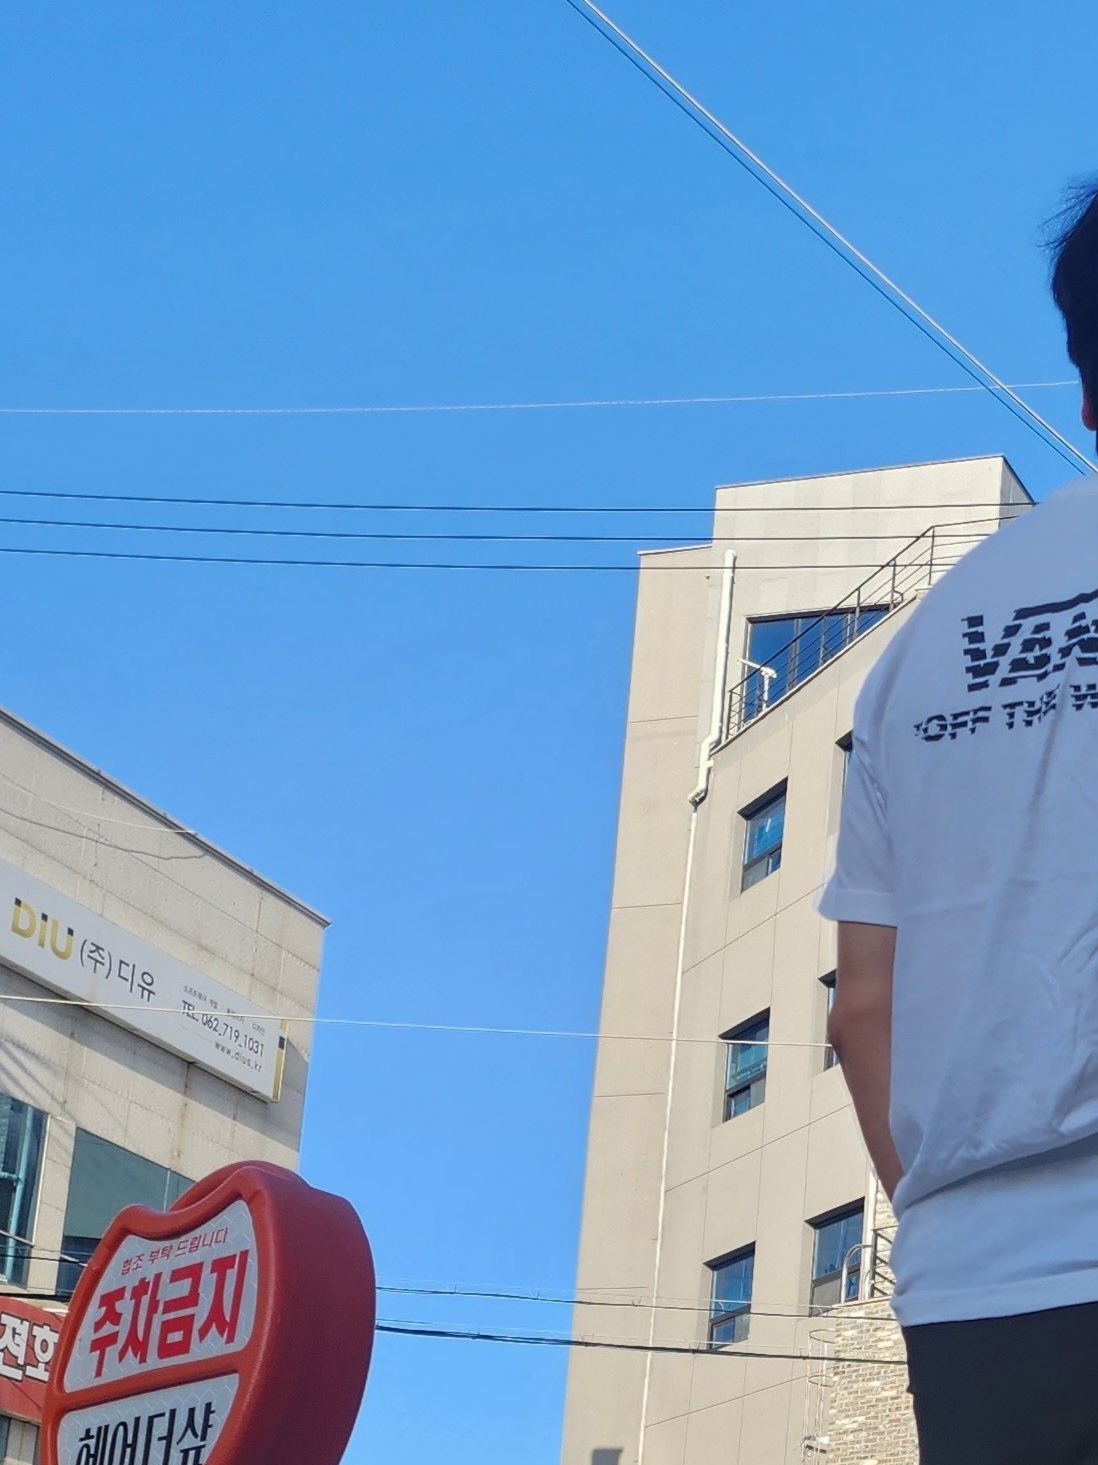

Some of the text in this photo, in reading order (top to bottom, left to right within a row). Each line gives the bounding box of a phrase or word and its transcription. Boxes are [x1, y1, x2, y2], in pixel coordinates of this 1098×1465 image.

[121, 1227, 229, 1276] 협조 부탁 드립니다
[89, 1249, 249, 1378] 주차금지
